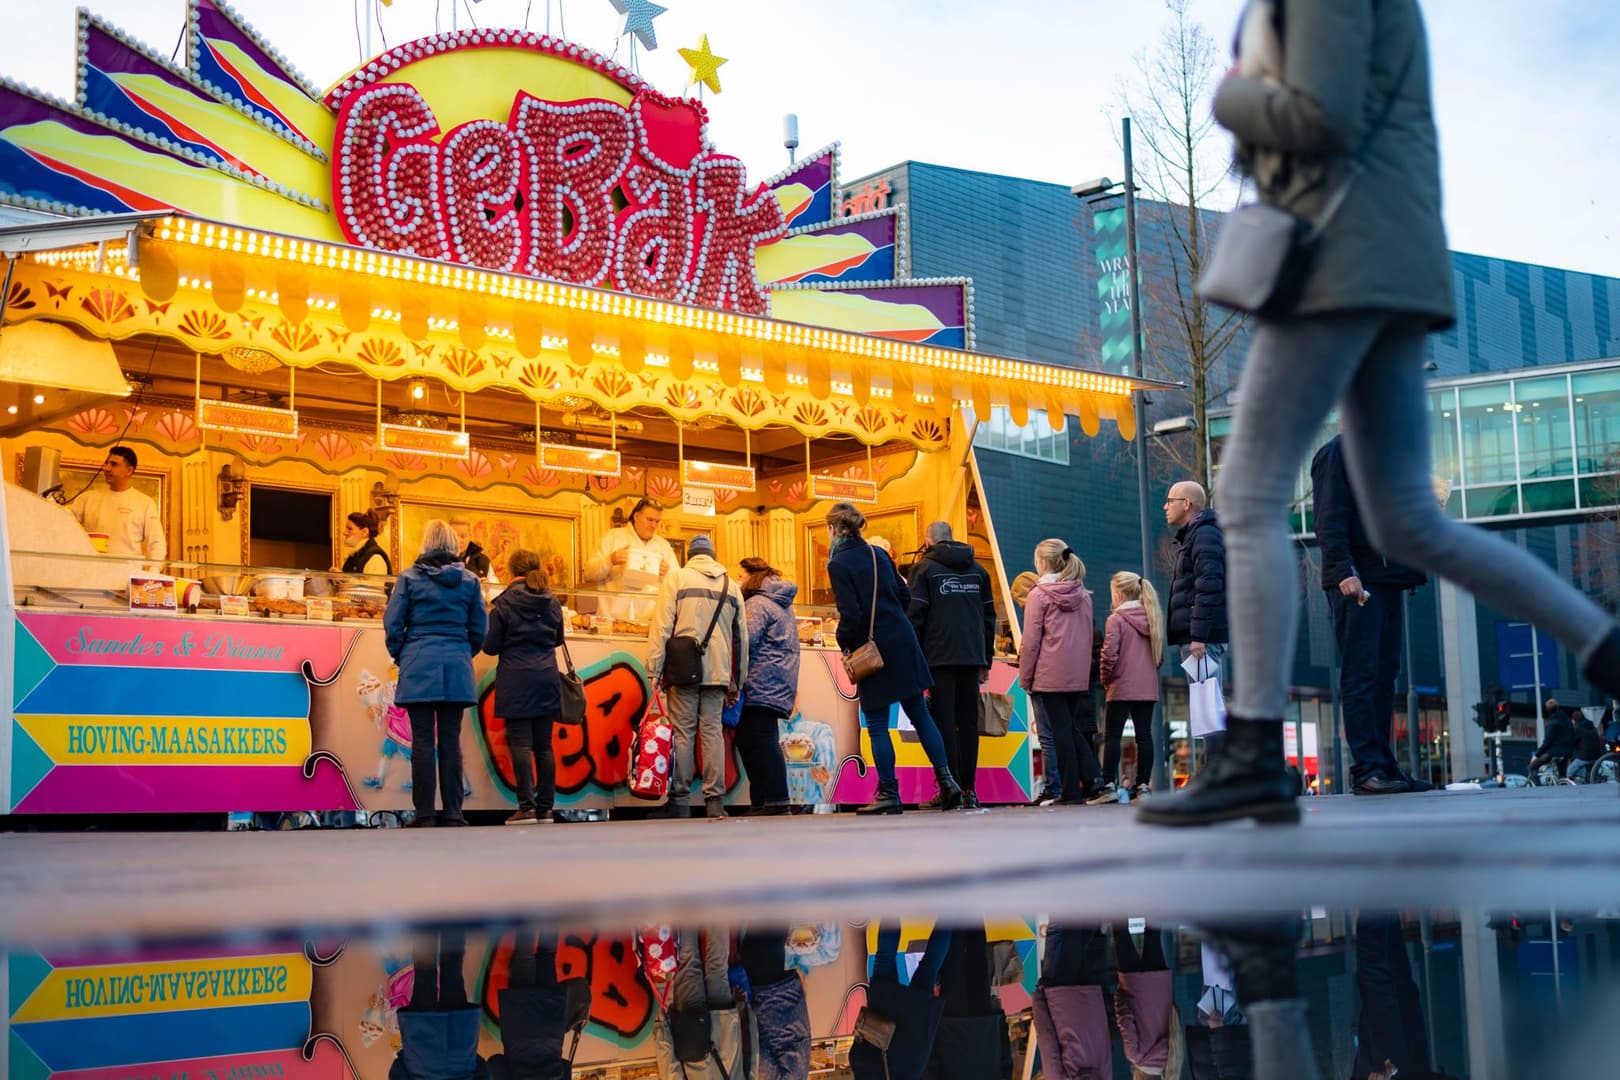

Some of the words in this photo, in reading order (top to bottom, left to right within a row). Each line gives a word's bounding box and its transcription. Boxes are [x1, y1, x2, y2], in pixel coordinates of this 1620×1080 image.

[332, 84, 789, 317] GeBak
[1100, 255, 1130, 273] WRA
[1104, 297, 1130, 315] YEA
[65, 626, 164, 656] Sander
[173, 631, 197, 657] &
[202, 631, 285, 661] Diana
[67, 724, 288, 755] HOVING-MAASAKKERS
